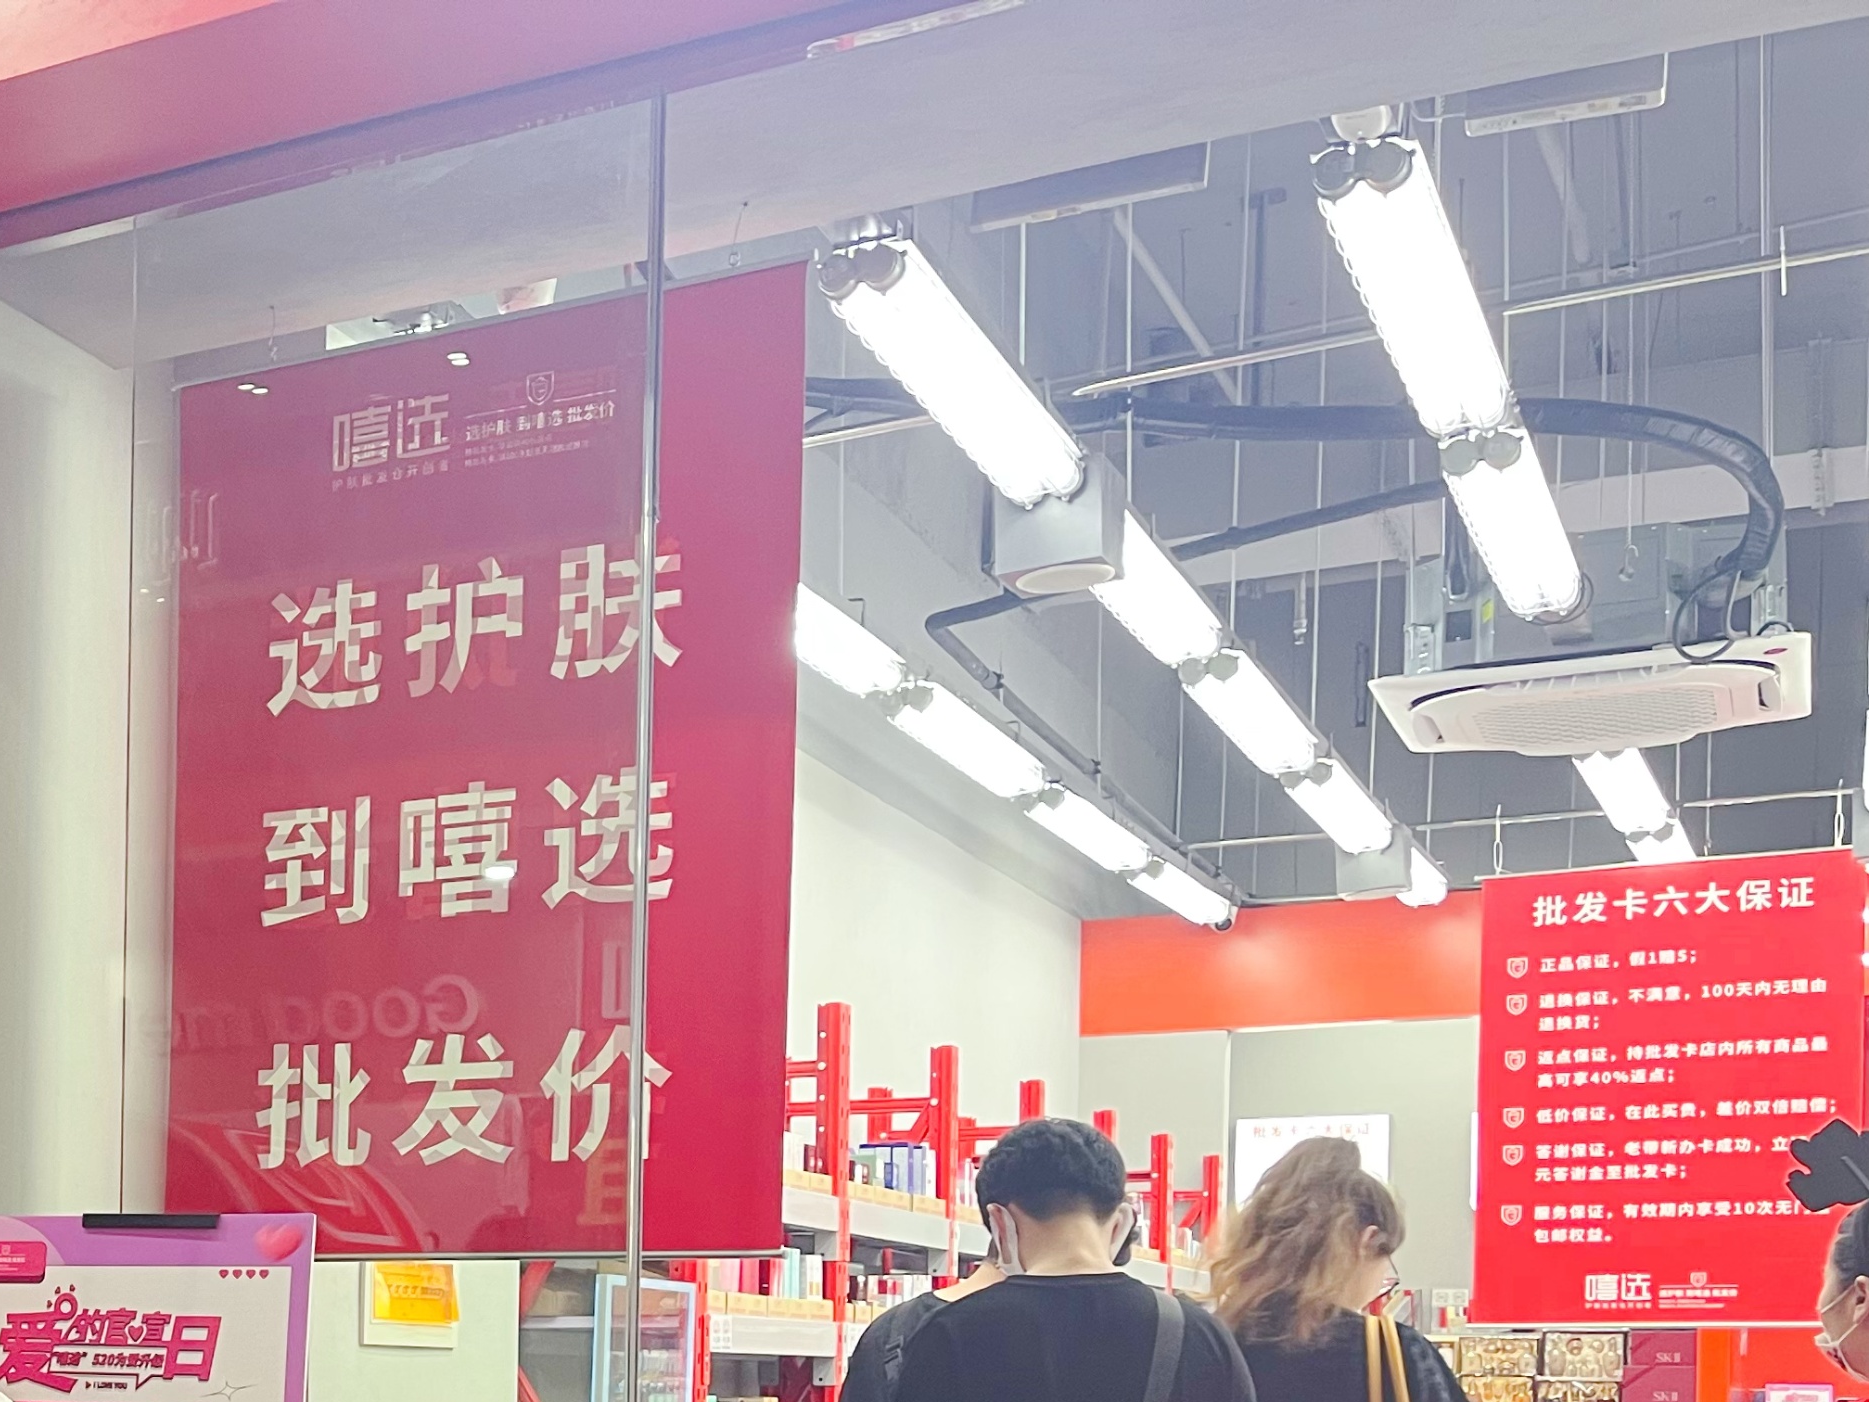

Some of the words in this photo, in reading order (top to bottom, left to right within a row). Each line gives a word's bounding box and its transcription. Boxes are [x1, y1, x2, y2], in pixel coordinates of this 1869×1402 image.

[267, 543, 682, 716] 选护肤
[261, 767, 674, 926] 到嘻选
[1533, 876, 1815, 927] 批发卡六大保证
[256, 1024, 672, 1169] 批发价
[1536, 1135, 1804, 1160] 答谢保证，老带新办卡成功，立
[1585, 1273, 1652, 1302] 嘻选
